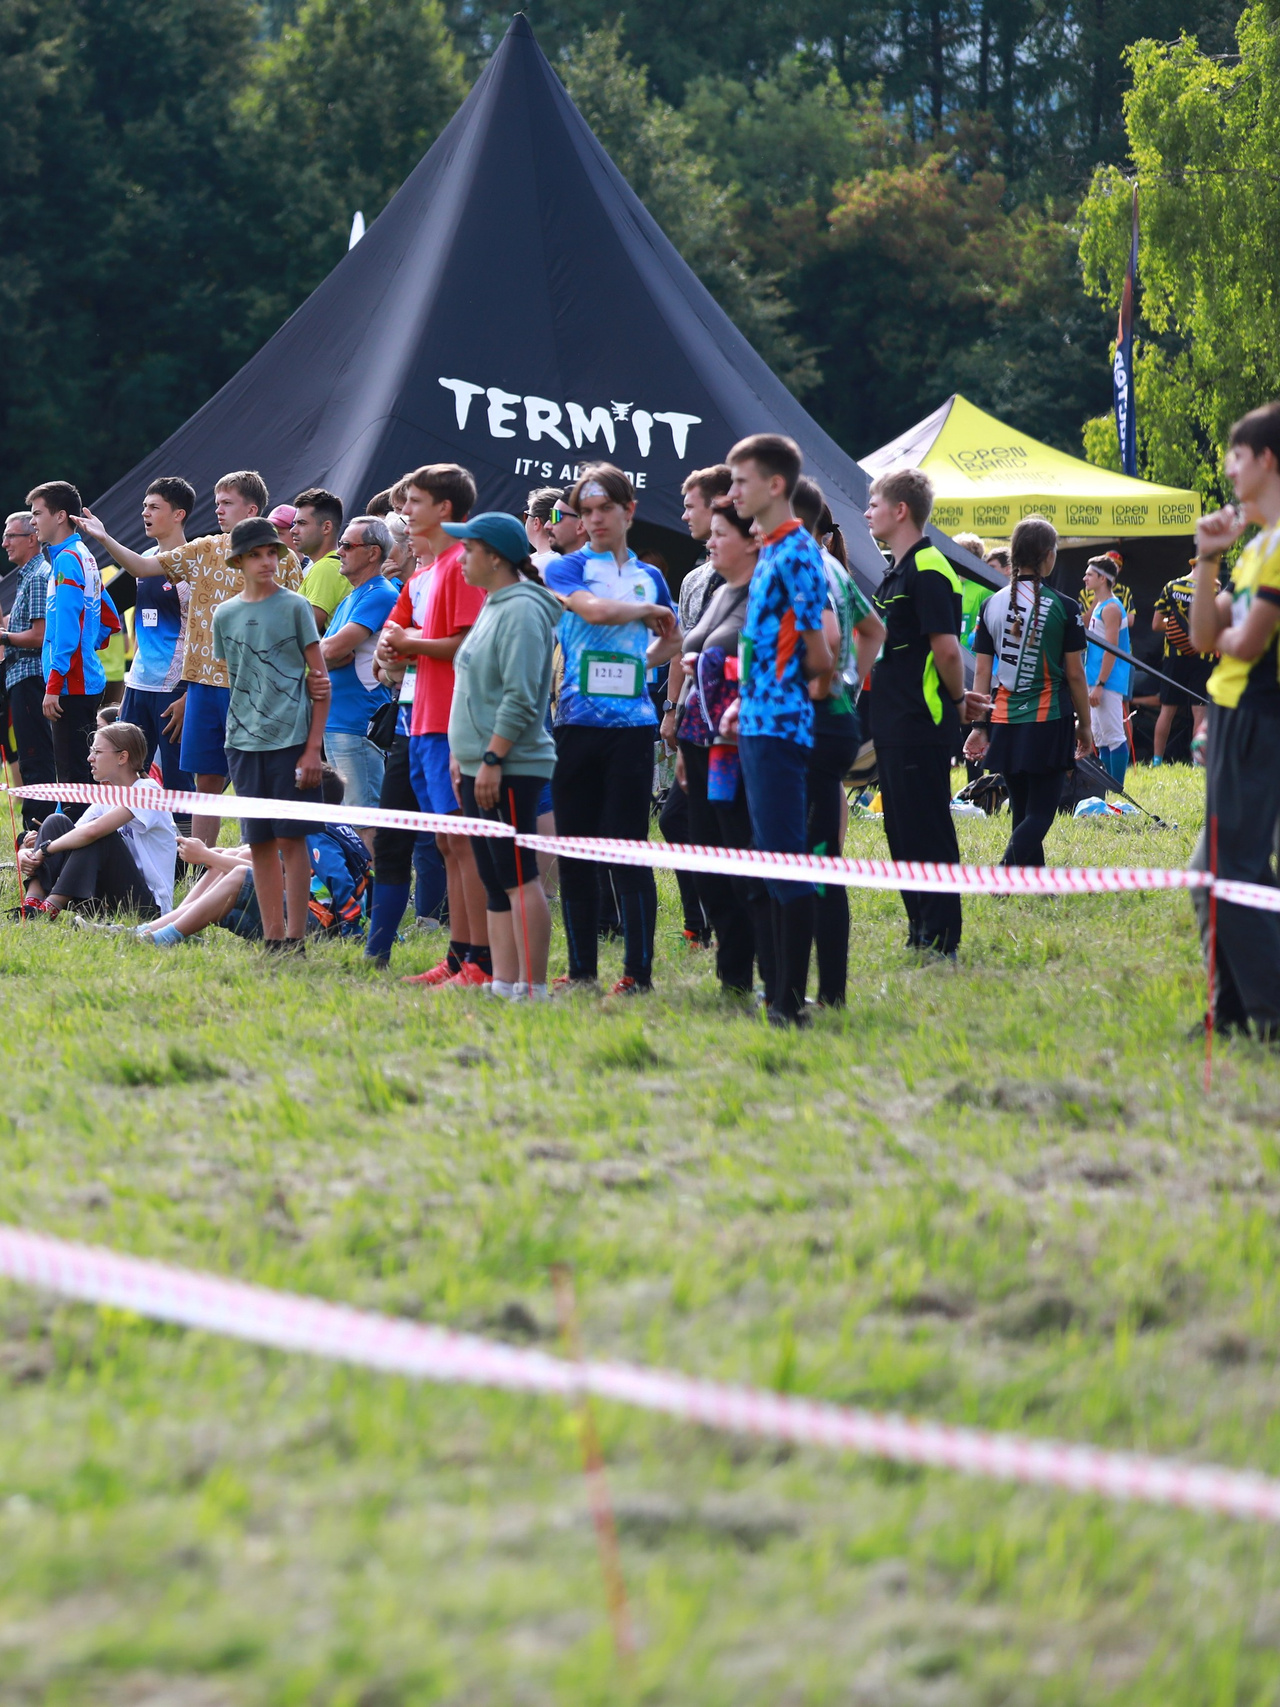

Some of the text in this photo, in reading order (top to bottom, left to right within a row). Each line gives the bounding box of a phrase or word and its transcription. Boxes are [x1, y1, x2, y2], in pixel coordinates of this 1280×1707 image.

[437, 376, 703, 460] TERMIT
[514, 457, 553, 479] IT'S
[1161, 504, 1195, 515] OPEN
[595, 668, 622, 678] 121.2
